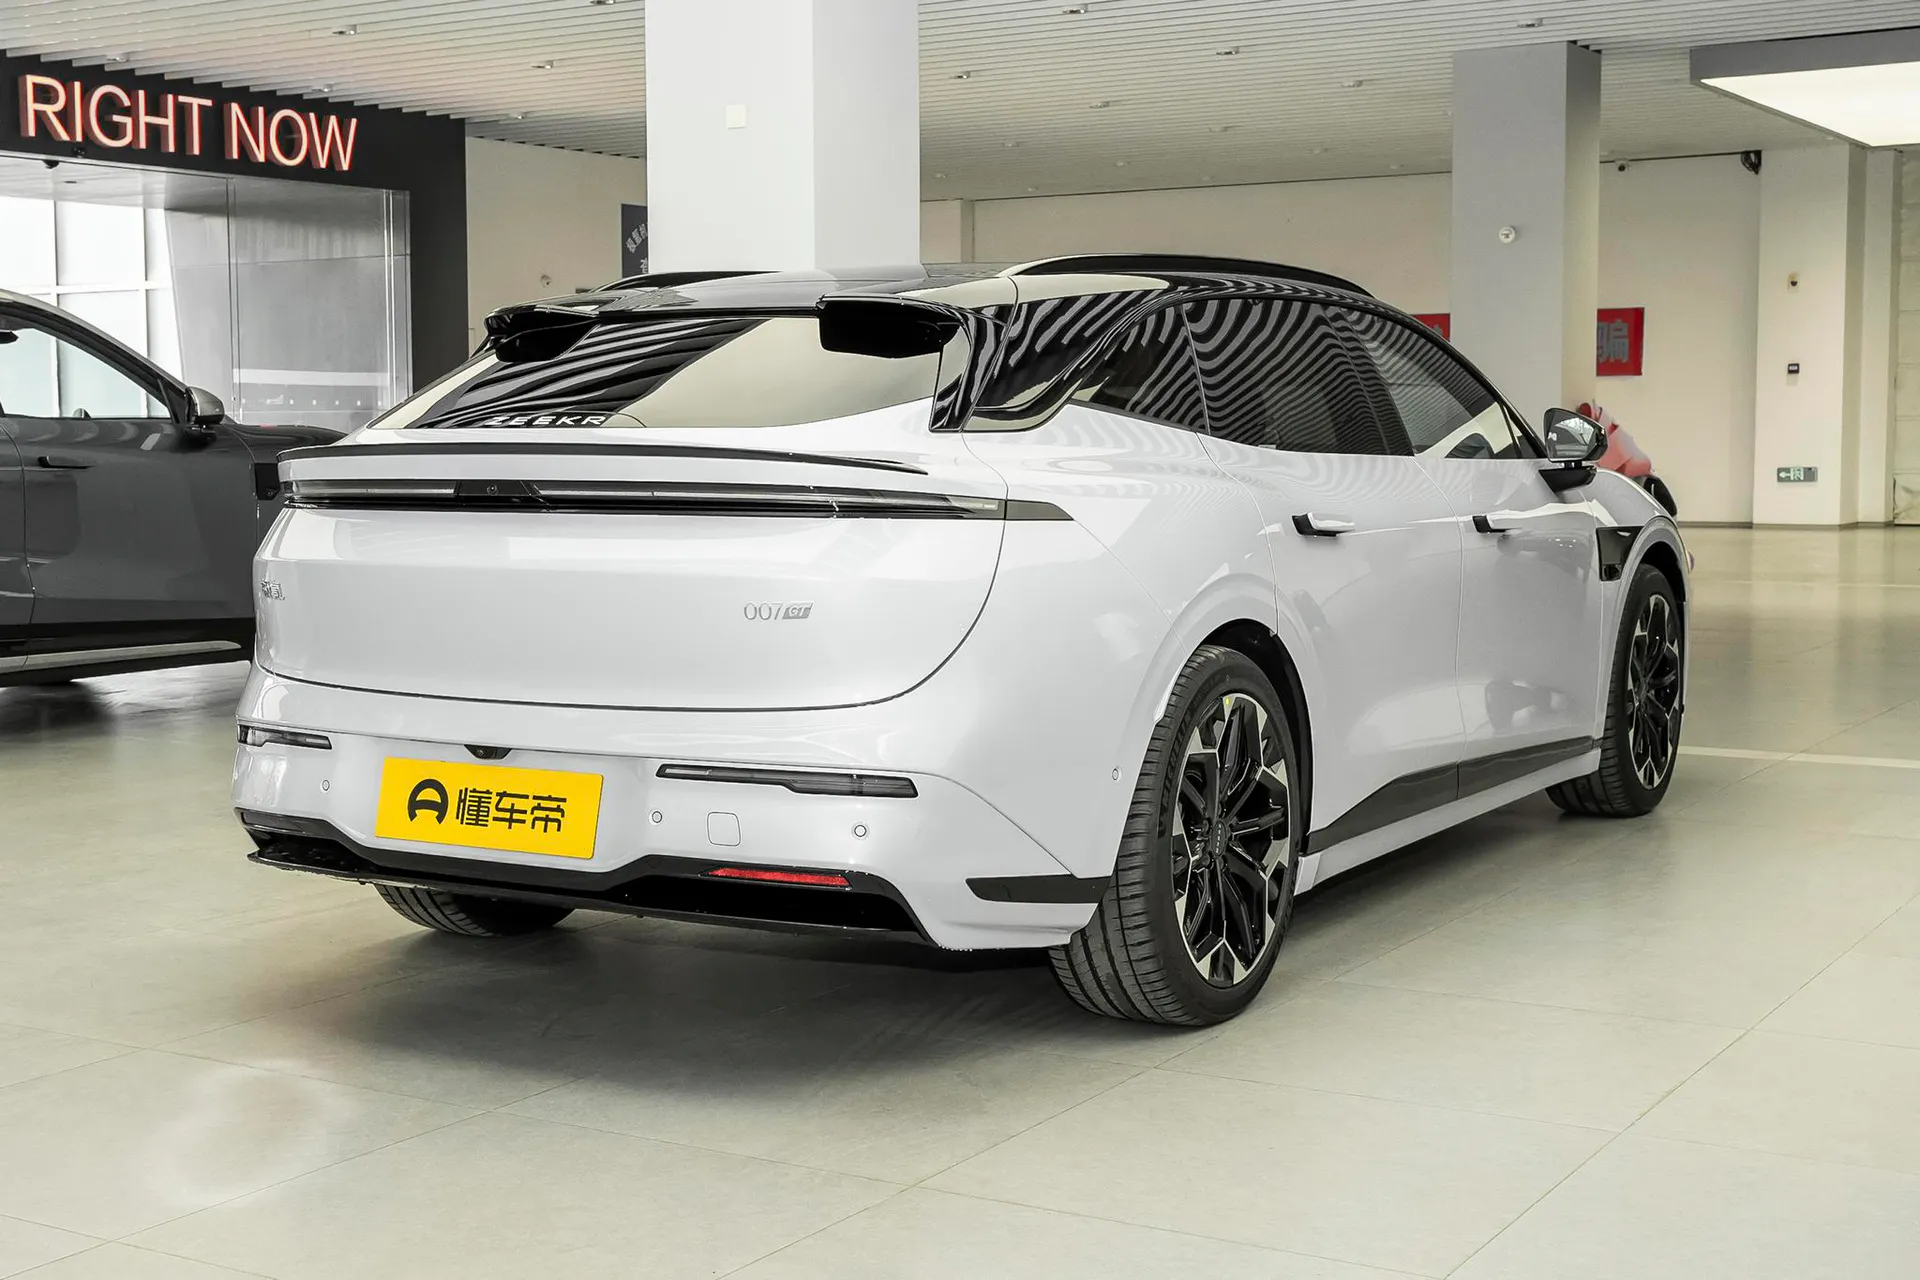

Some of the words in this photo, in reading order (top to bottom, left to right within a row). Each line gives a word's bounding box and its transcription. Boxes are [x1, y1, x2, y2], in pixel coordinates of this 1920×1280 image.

[20, 74, 213, 155] RIGHT
[223, 102, 357, 171] NOW
[484, 415, 607, 427] ZEEKR
[743, 602, 783, 620] 007
[456, 787, 567, 833] 懂车帝
